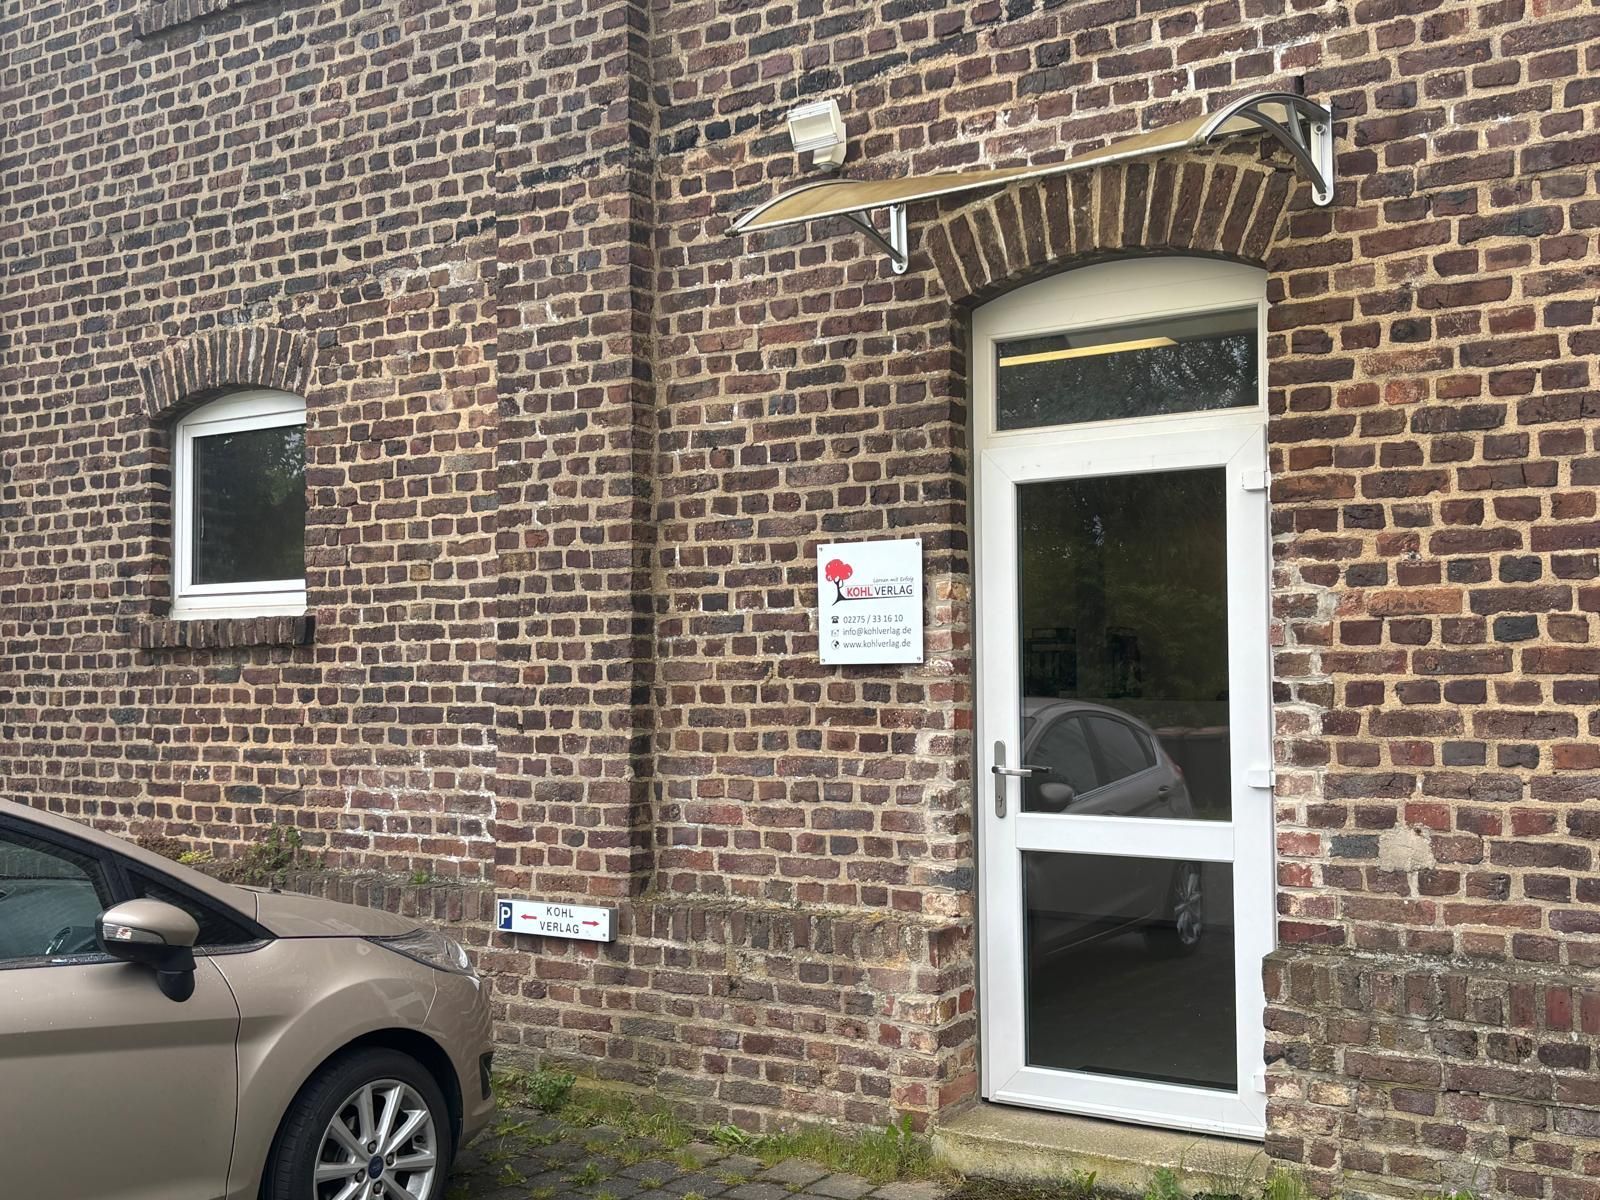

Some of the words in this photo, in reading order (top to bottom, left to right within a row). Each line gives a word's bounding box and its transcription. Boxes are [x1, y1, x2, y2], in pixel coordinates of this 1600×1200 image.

[847, 587, 873, 597] KOHL
[874, 585, 913, 596] VERLAG
[843, 616, 865, 624] 02275
[872, 615, 881, 623] 33
[884, 615, 893, 623] 16
[895, 614, 903, 622] 10
[843, 639, 911, 649] www.kohlverlag.de
[500, 907, 511, 926] P
[546, 906, 574, 918] KOHL
[540, 921, 579, 934] VERLAG
